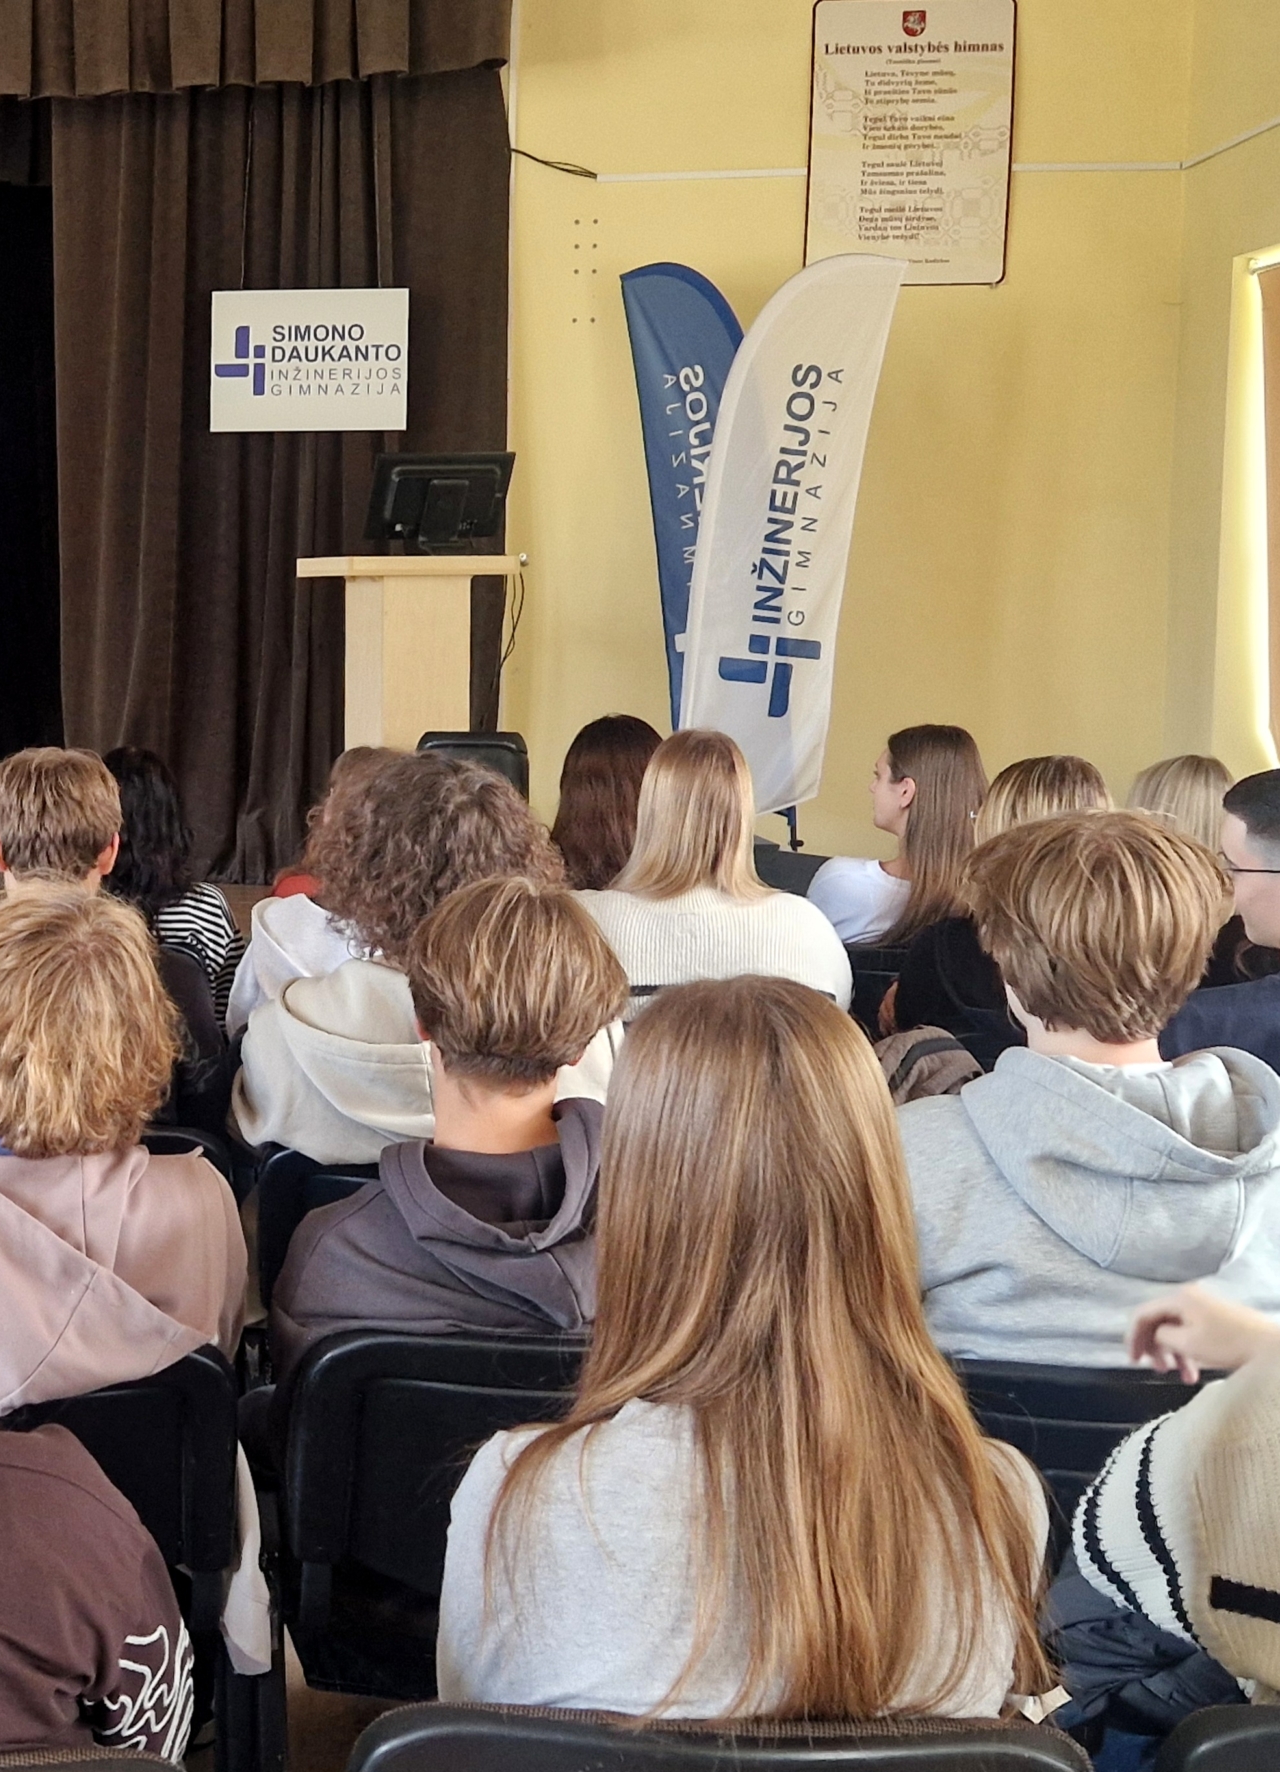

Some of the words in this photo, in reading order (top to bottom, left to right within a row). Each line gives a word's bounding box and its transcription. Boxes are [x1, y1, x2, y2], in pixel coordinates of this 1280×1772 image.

[824, 43, 883, 55] Lietuvos
[887, 41, 950, 57] valstybės
[954, 40, 1004, 53] himnas
[272, 324, 365, 342] SIMONO
[271, 344, 402, 363] DAUKANTO
[270, 366, 402, 381] INŽINERIJOS
[270, 383, 402, 396] GIMNAZIJA
[750, 363, 823, 625] INŽINERIJOS
[787, 367, 845, 627] GIMNAZIJA
